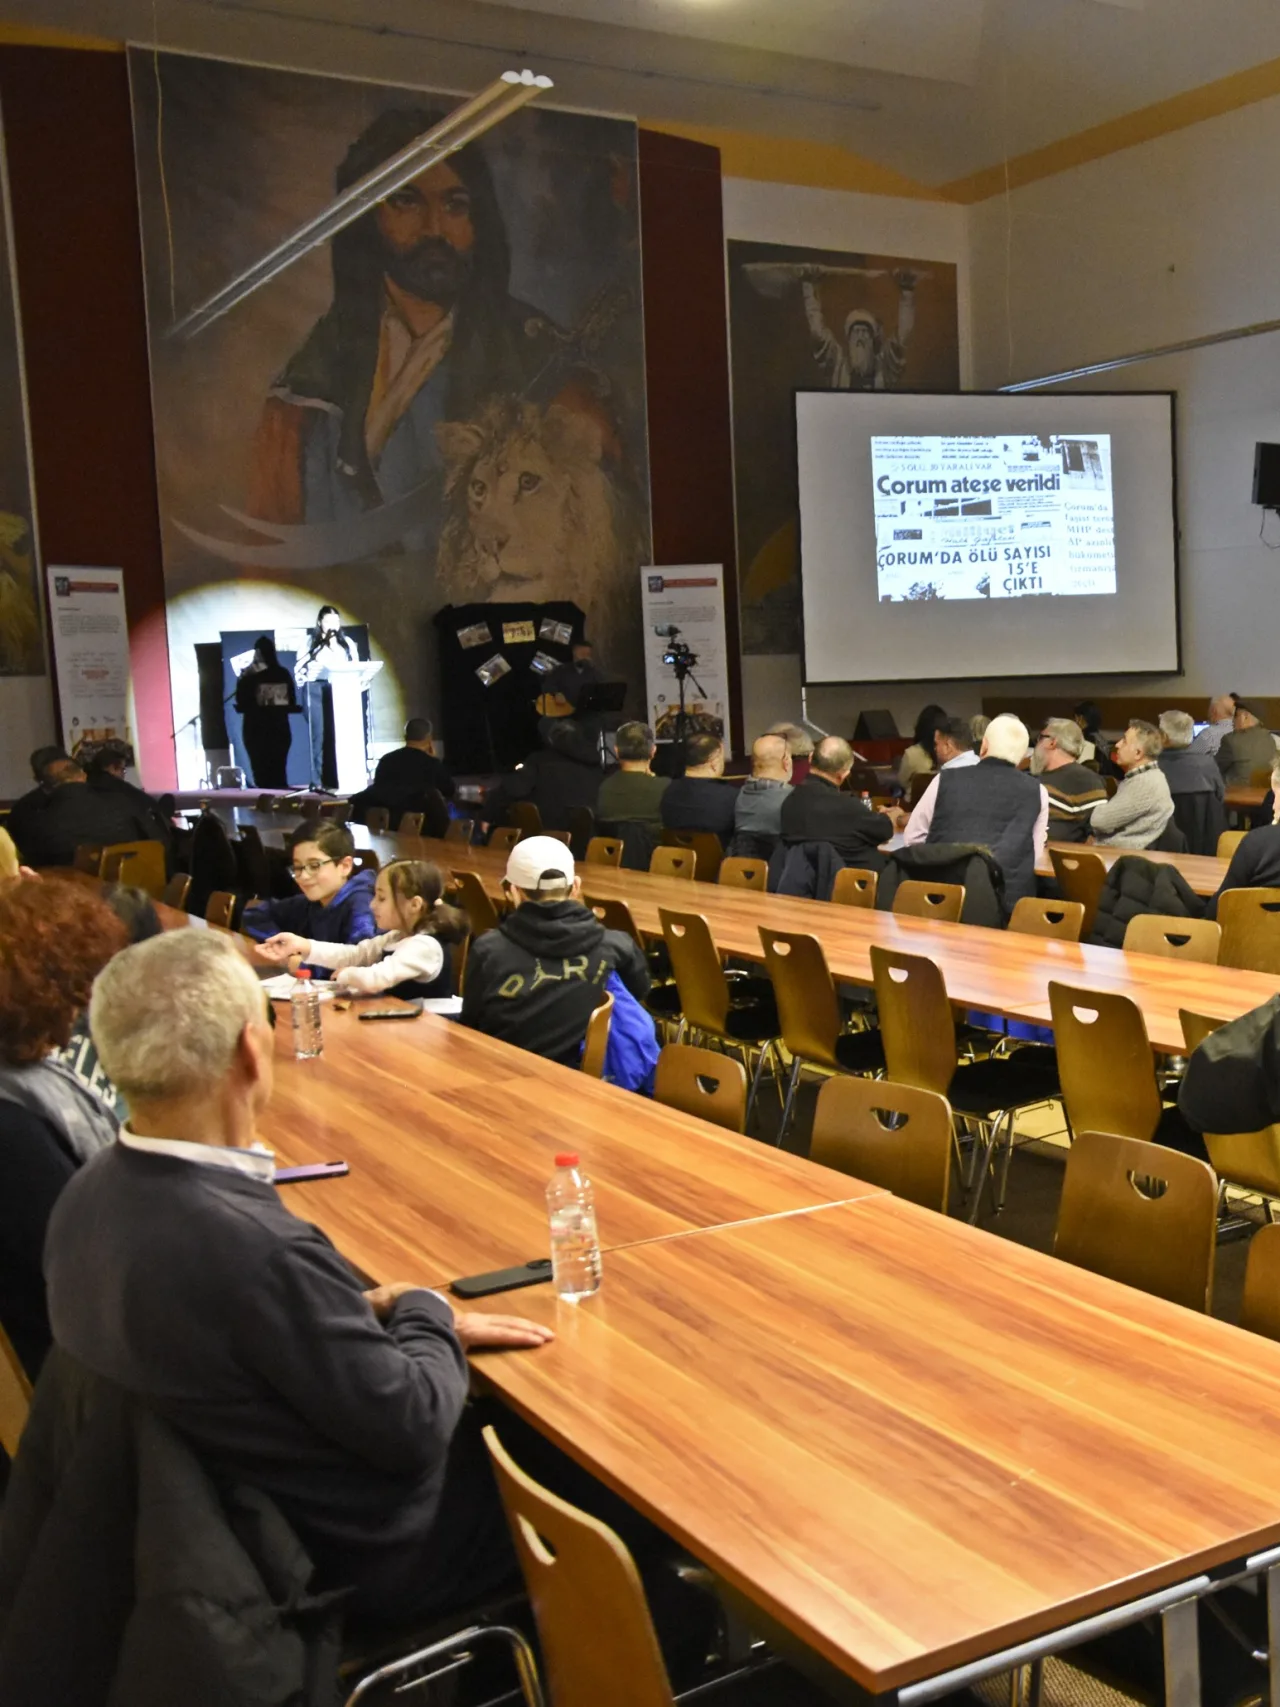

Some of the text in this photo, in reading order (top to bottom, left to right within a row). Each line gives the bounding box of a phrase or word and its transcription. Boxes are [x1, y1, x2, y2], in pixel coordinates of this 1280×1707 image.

[877, 475, 947, 496] Çorum
[1006, 473, 1060, 492] verildi
[877, 546, 1051, 571] ÇORUM'DA ÖLÜ SAYISI
[1008, 562, 1038, 575] 15'E
[1003, 576, 1042, 594] ÇIKTI
